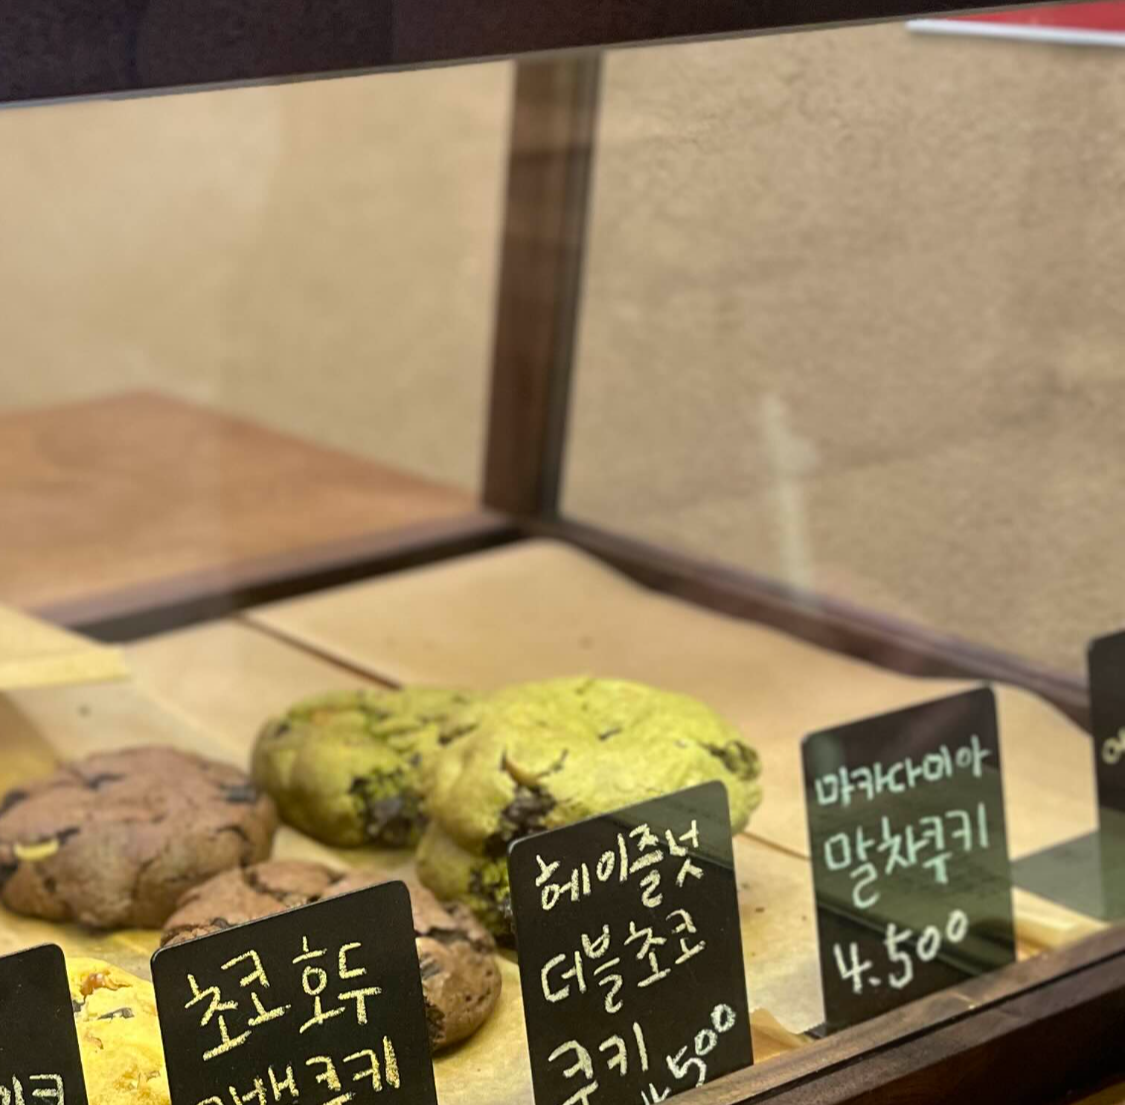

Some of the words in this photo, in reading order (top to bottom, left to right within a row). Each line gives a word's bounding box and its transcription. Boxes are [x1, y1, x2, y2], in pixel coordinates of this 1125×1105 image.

[815, 734, 992, 807] 마카다미아
[535, 819, 705, 911] 헤이즐넛
[824, 801, 990, 909] 말차쿠키
[833, 909, 969, 994] 4.500
[184, 949, 291, 1062] 초코
[292, 935, 383, 1034] 호두
